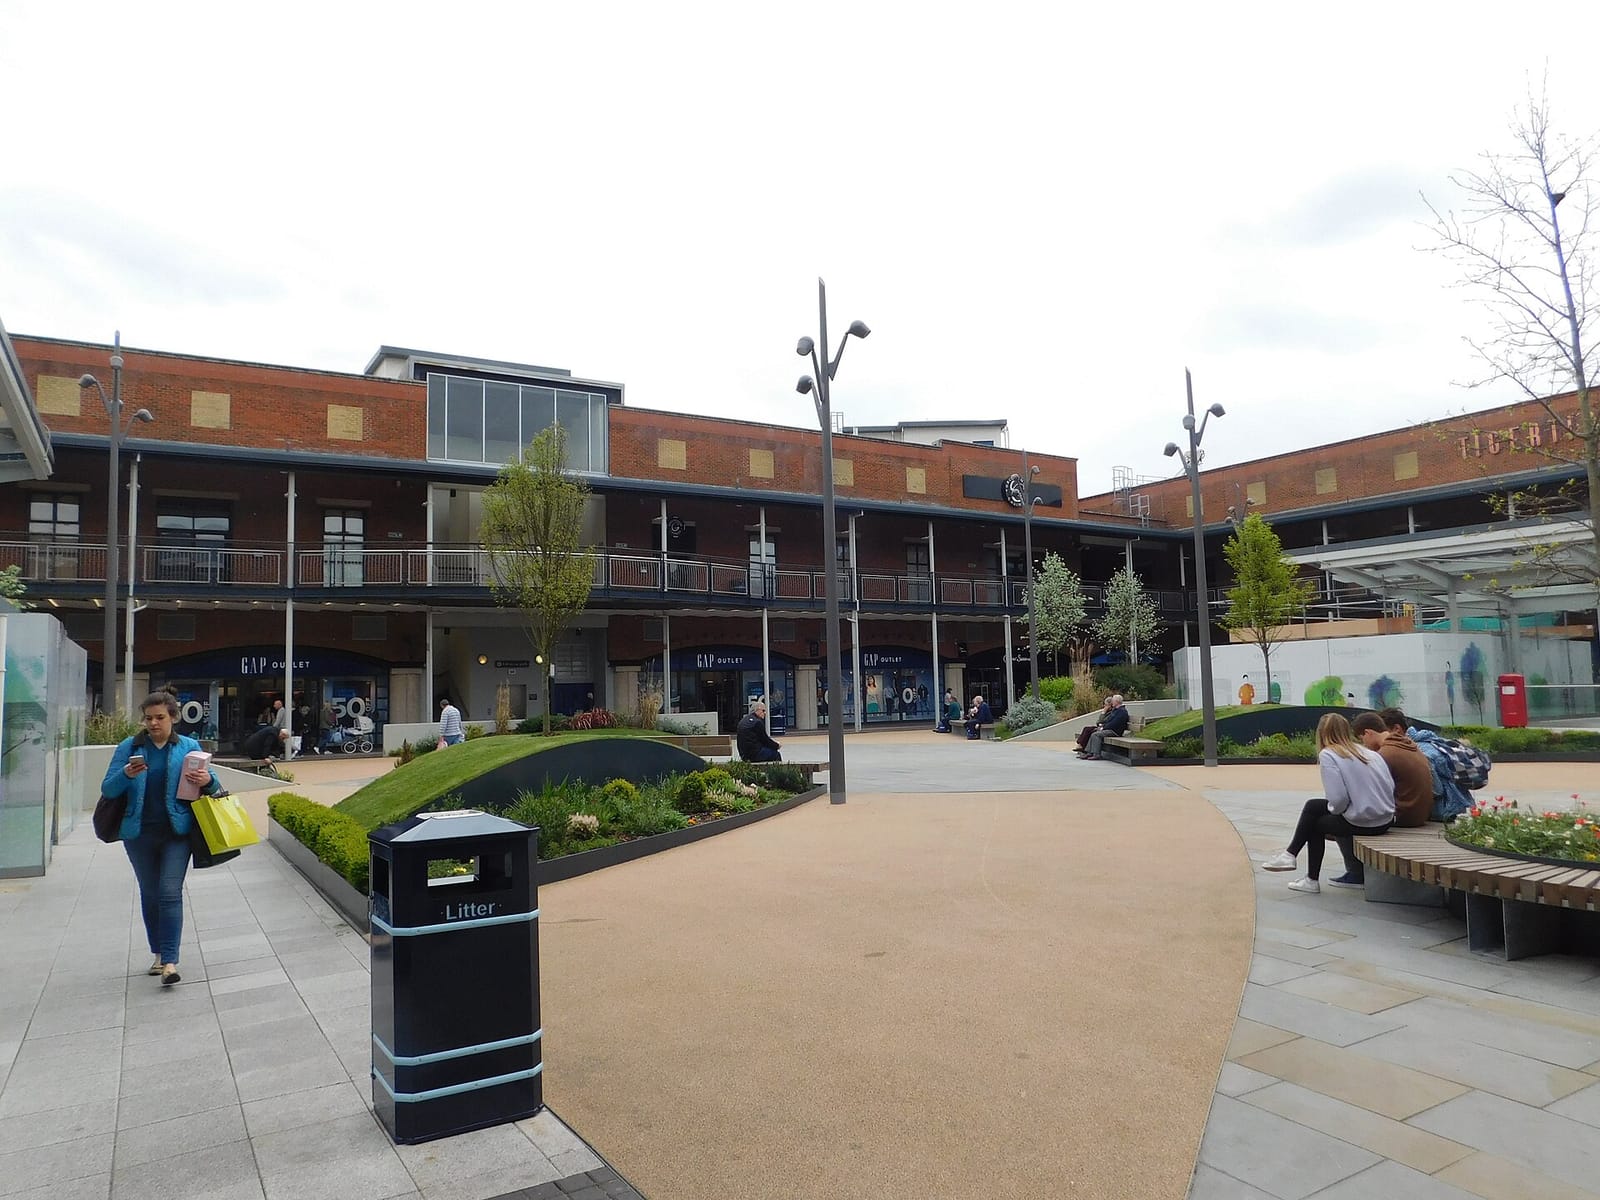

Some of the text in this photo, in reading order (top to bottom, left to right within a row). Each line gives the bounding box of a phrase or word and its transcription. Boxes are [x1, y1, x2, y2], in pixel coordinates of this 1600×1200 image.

[241, 656, 310, 674] GAP OULET
[697, 653, 714, 668] GAP
[864, 653, 879, 667] GAP
[331, 697, 366, 719] 50
[446, 902, 496, 920] Litter
